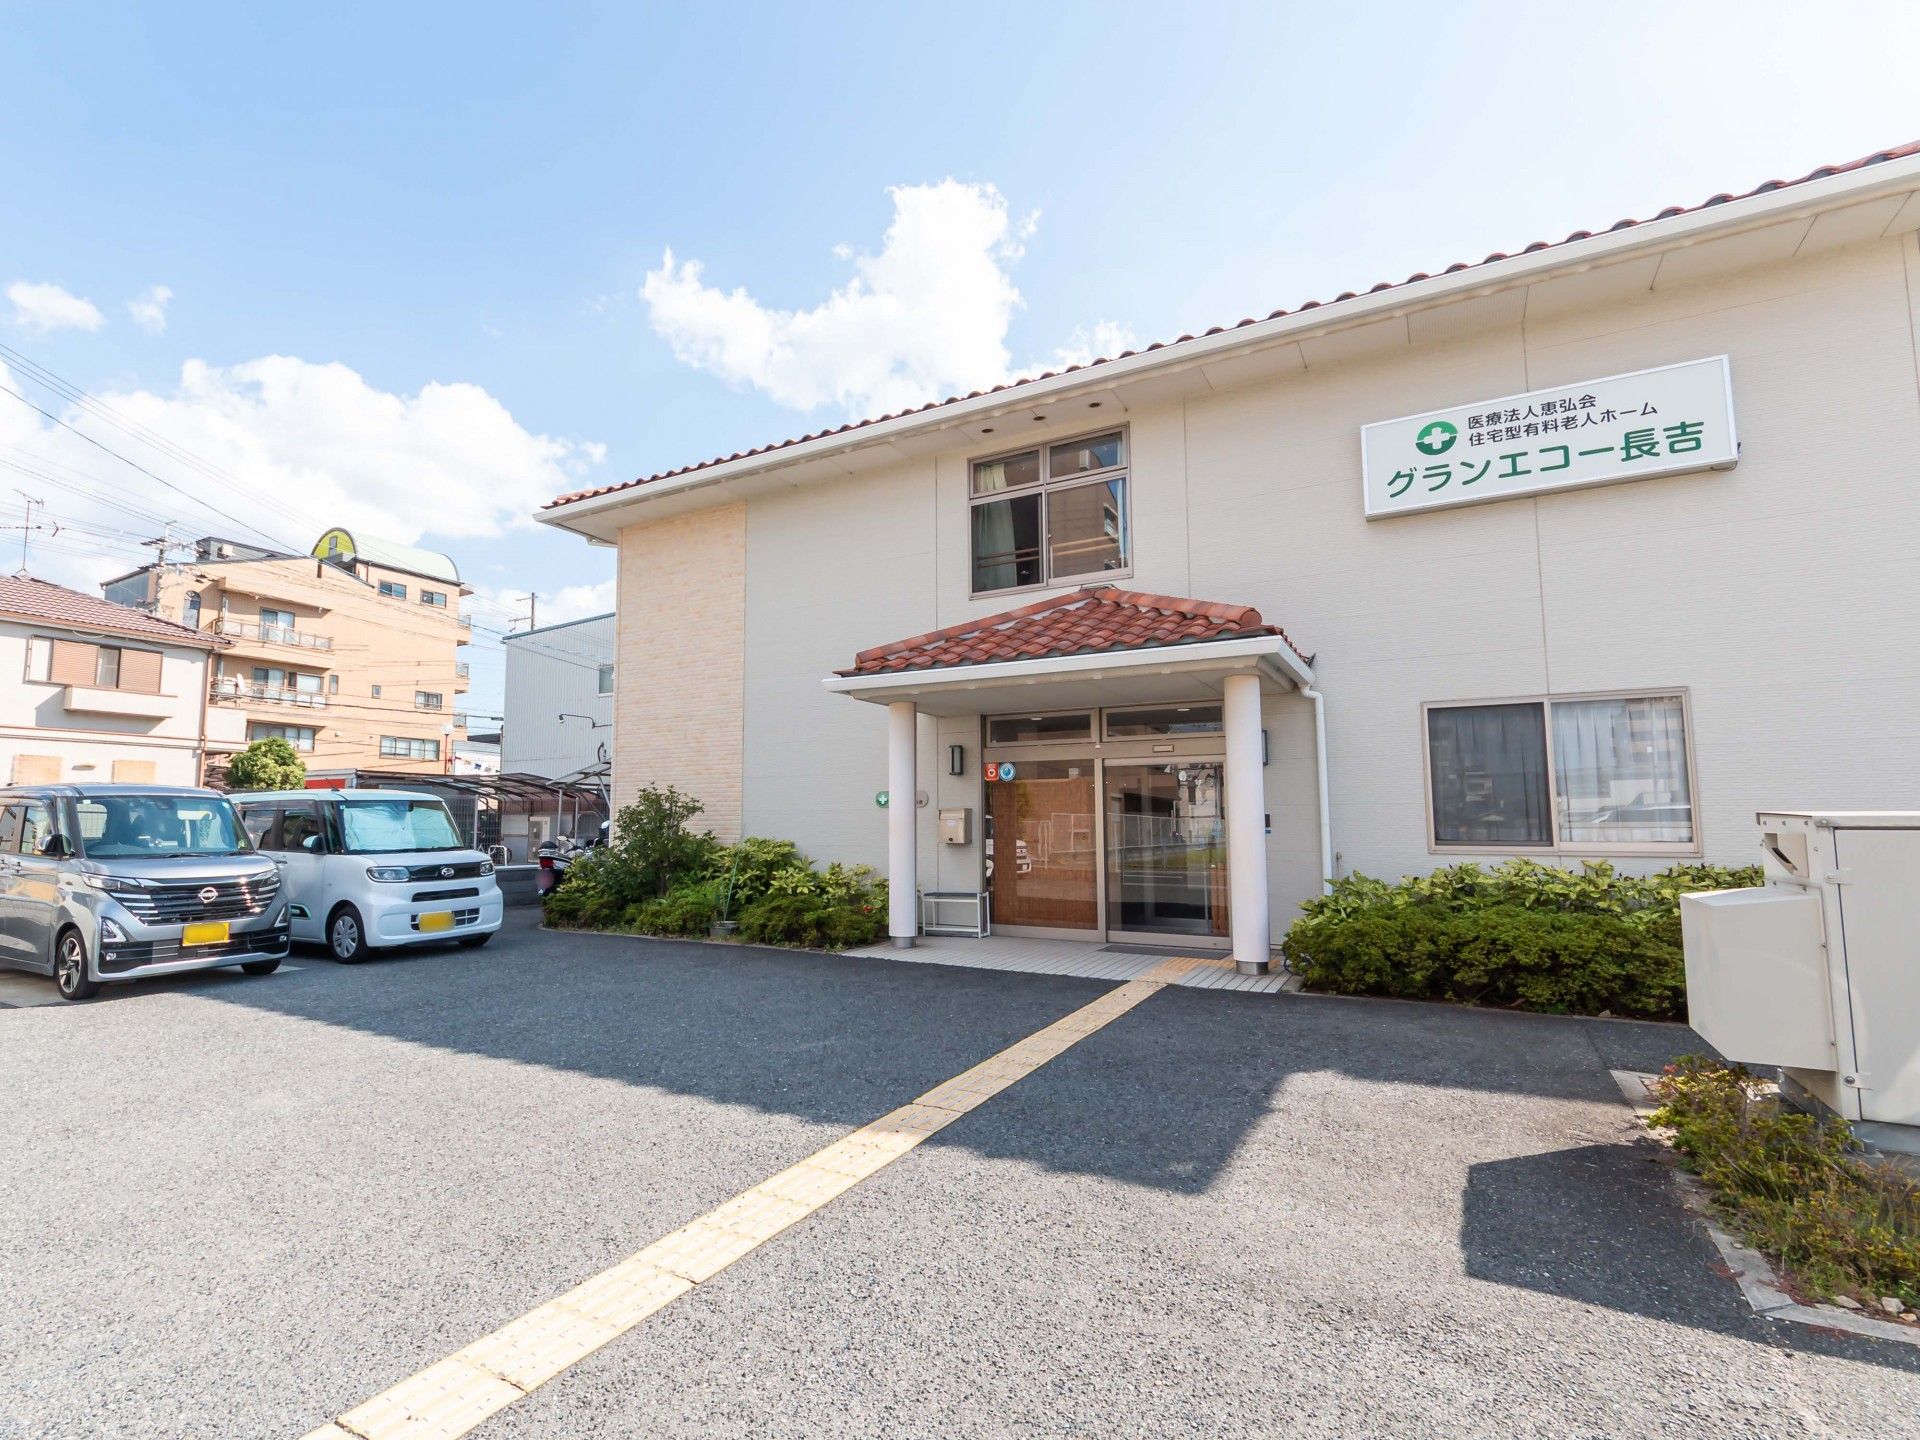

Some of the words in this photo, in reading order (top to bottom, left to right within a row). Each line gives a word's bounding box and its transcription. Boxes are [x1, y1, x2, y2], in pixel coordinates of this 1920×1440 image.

[1468, 394, 1596, 429] 医療法人恵弘会
[1469, 402, 1658, 447] 住宅型有料老人ホーム
[1387, 421, 1704, 498] グランエコー長吉
